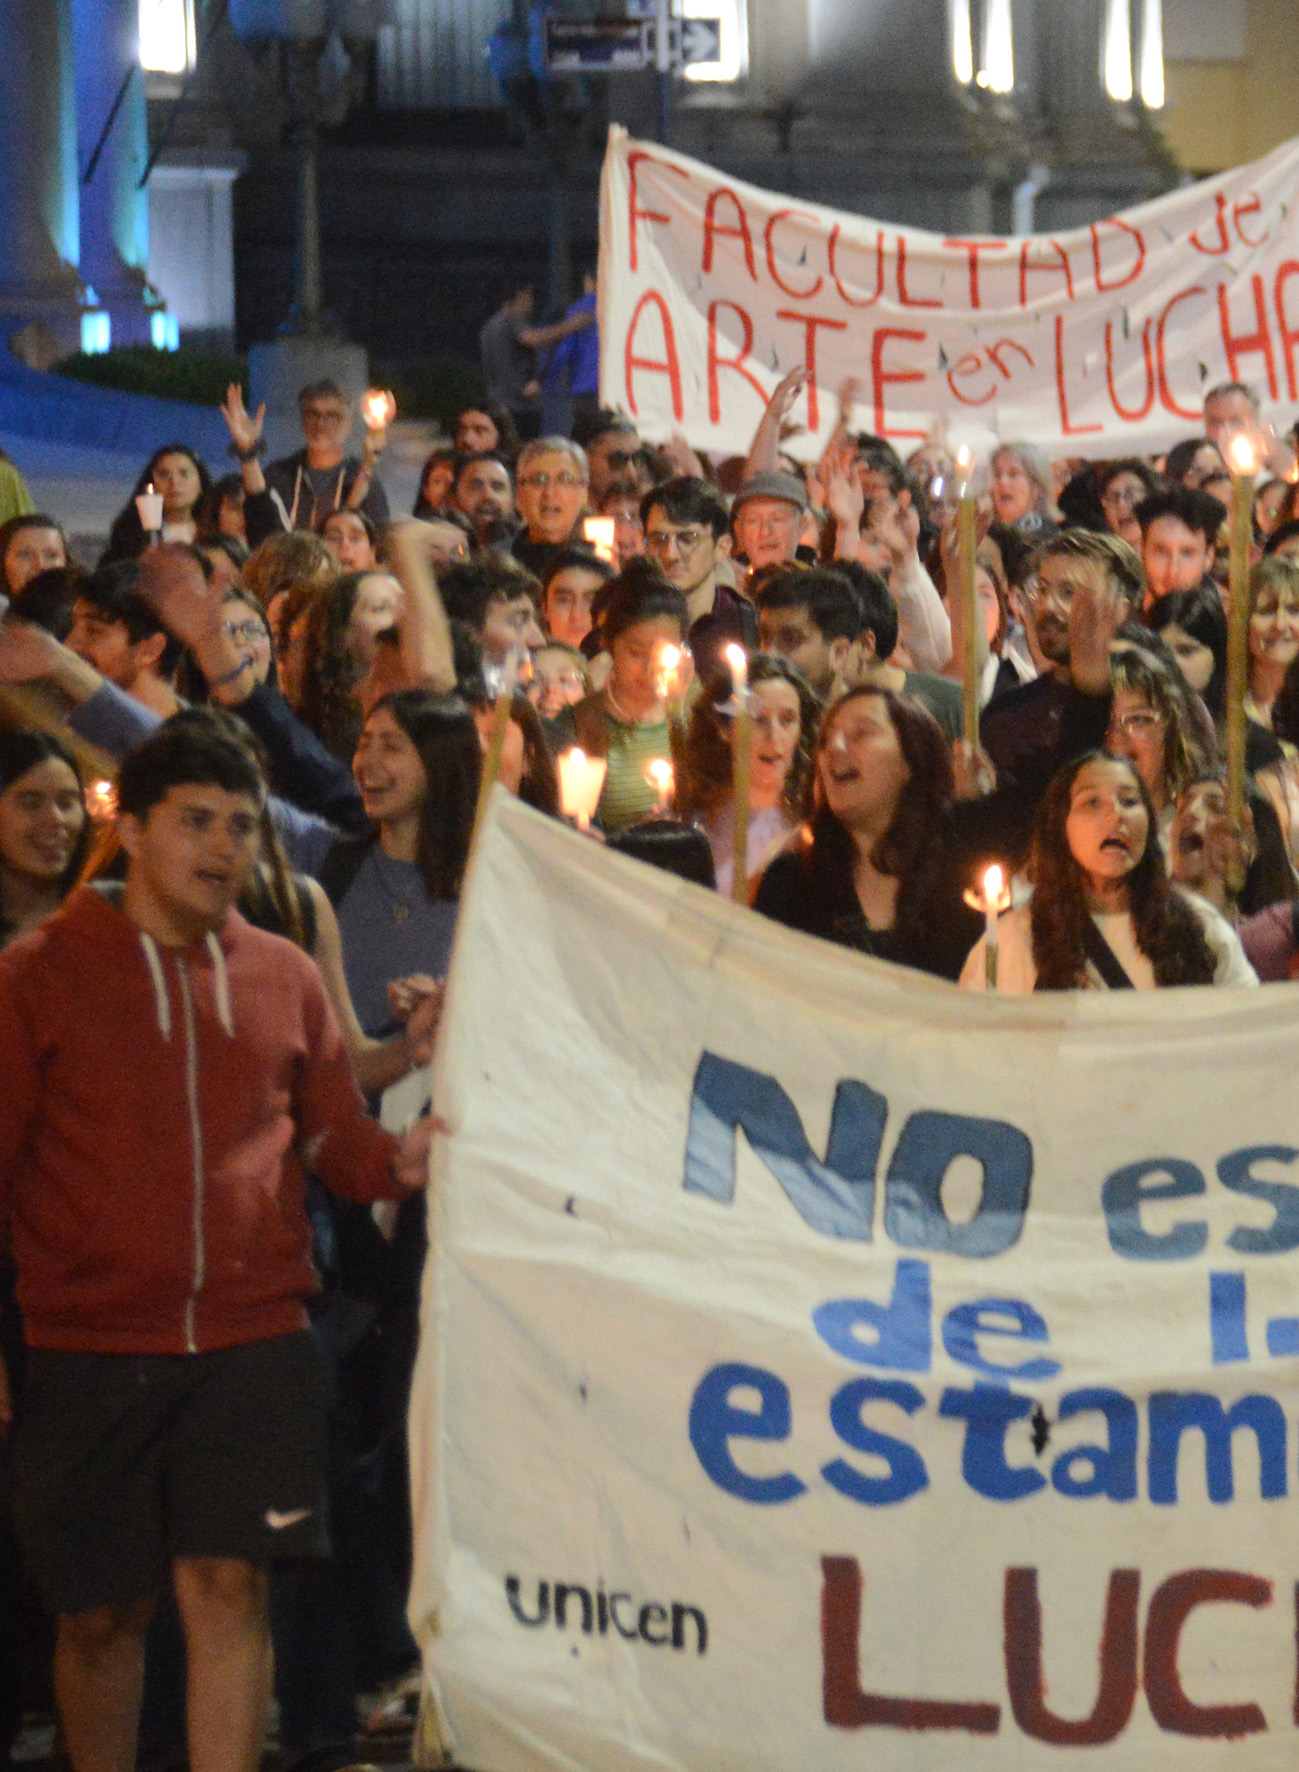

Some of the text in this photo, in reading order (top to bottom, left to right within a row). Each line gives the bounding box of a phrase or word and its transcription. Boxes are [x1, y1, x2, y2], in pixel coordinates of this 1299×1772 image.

[628, 151, 1146, 309] FACULTAD
[625, 289, 928, 438] ARTE
[946, 339, 1035, 406] en
[811, 1257, 1062, 1382] de
[505, 1573, 708, 1656] unicen
